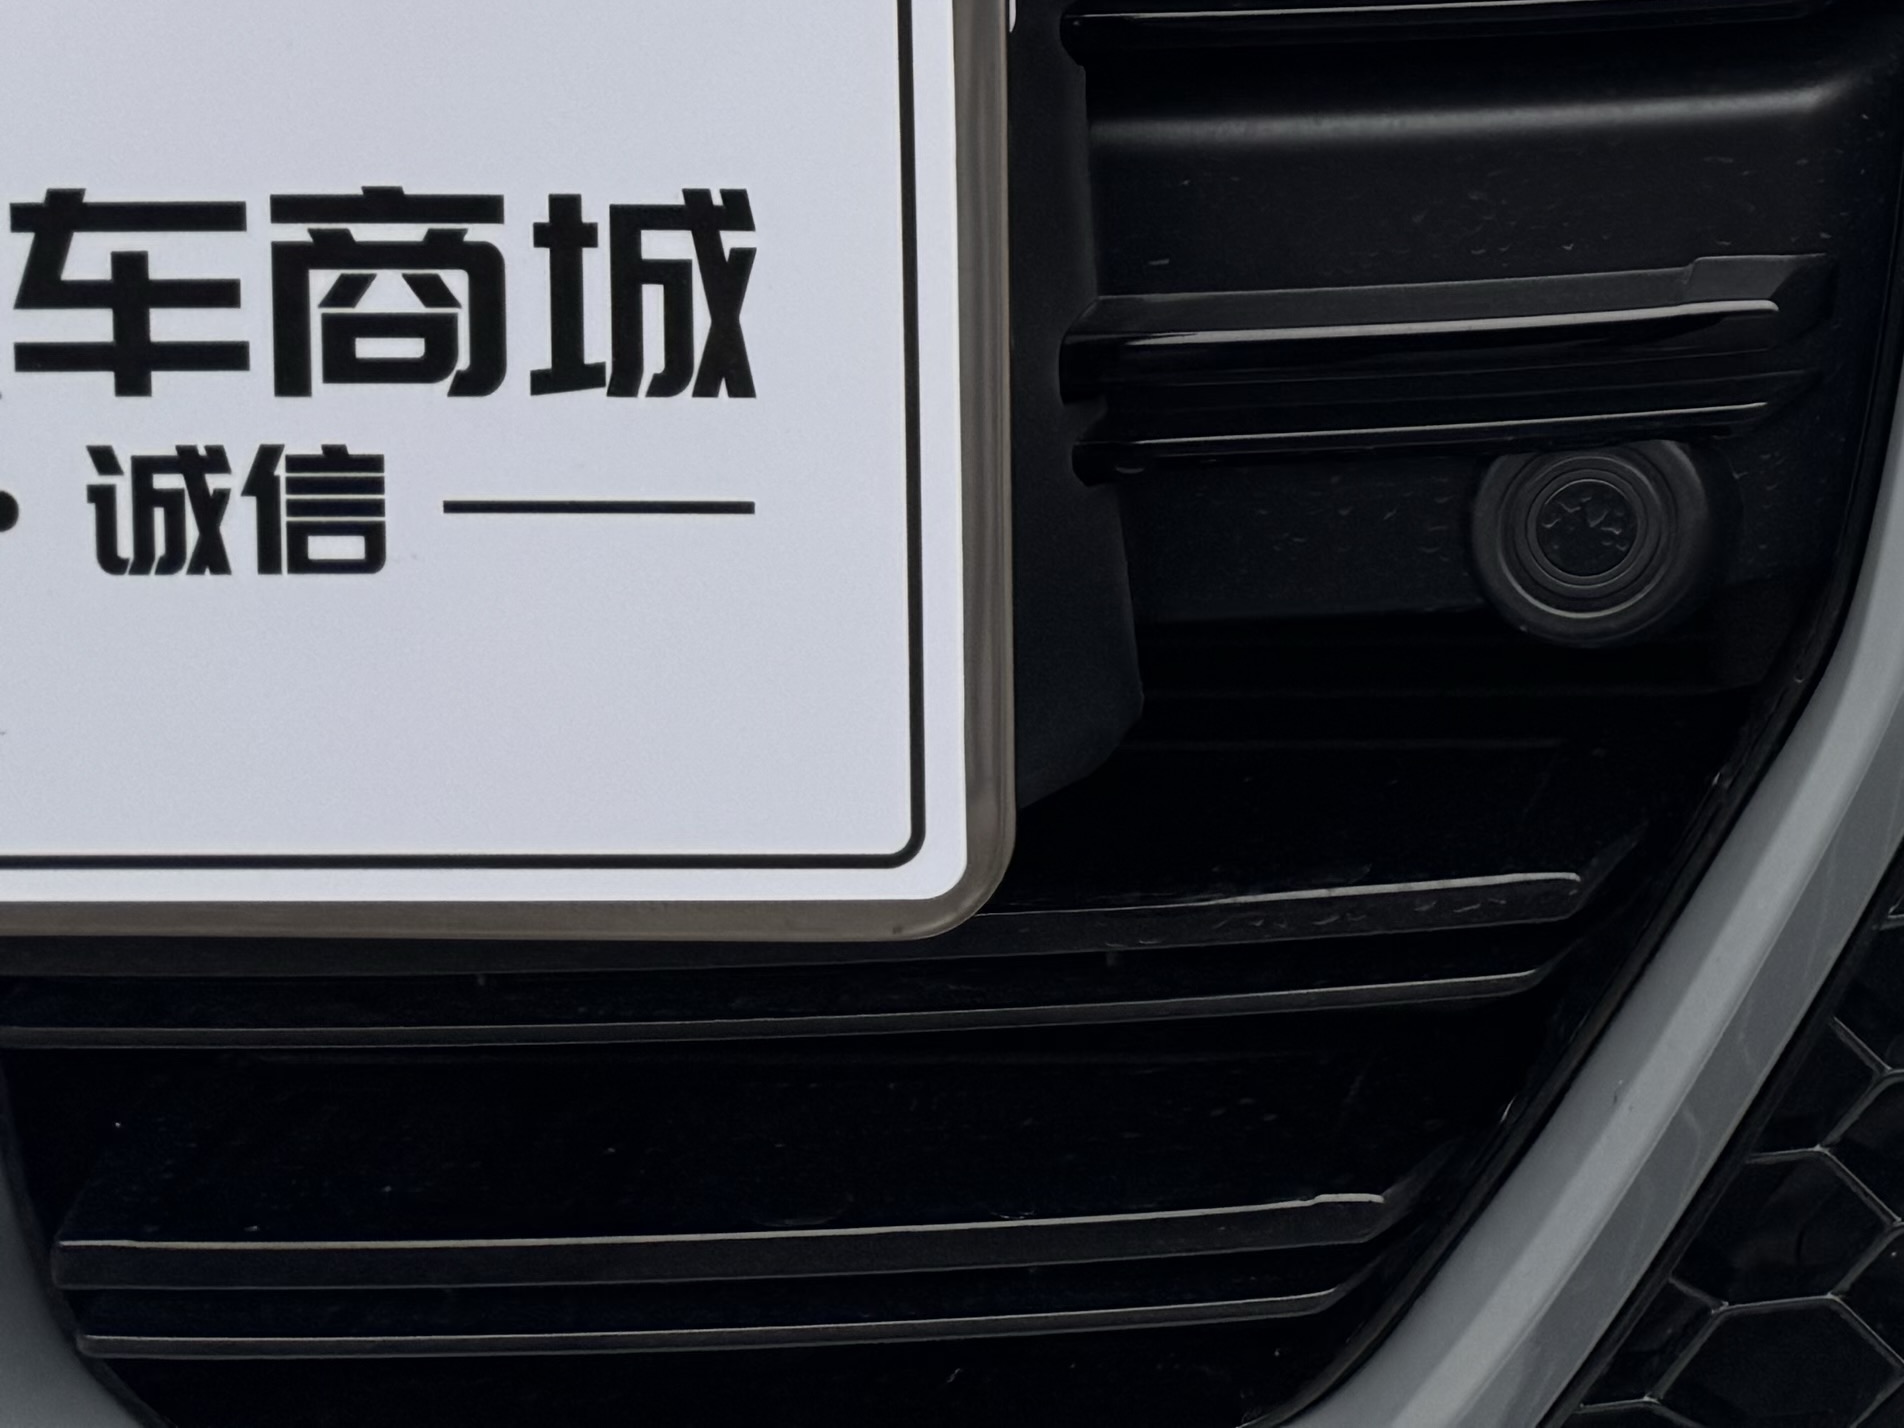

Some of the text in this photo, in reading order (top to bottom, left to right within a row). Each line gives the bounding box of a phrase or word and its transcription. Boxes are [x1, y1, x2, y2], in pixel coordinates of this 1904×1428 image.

[8, 185, 757, 399] 车商城
[85, 443, 387, 577] 诚信
